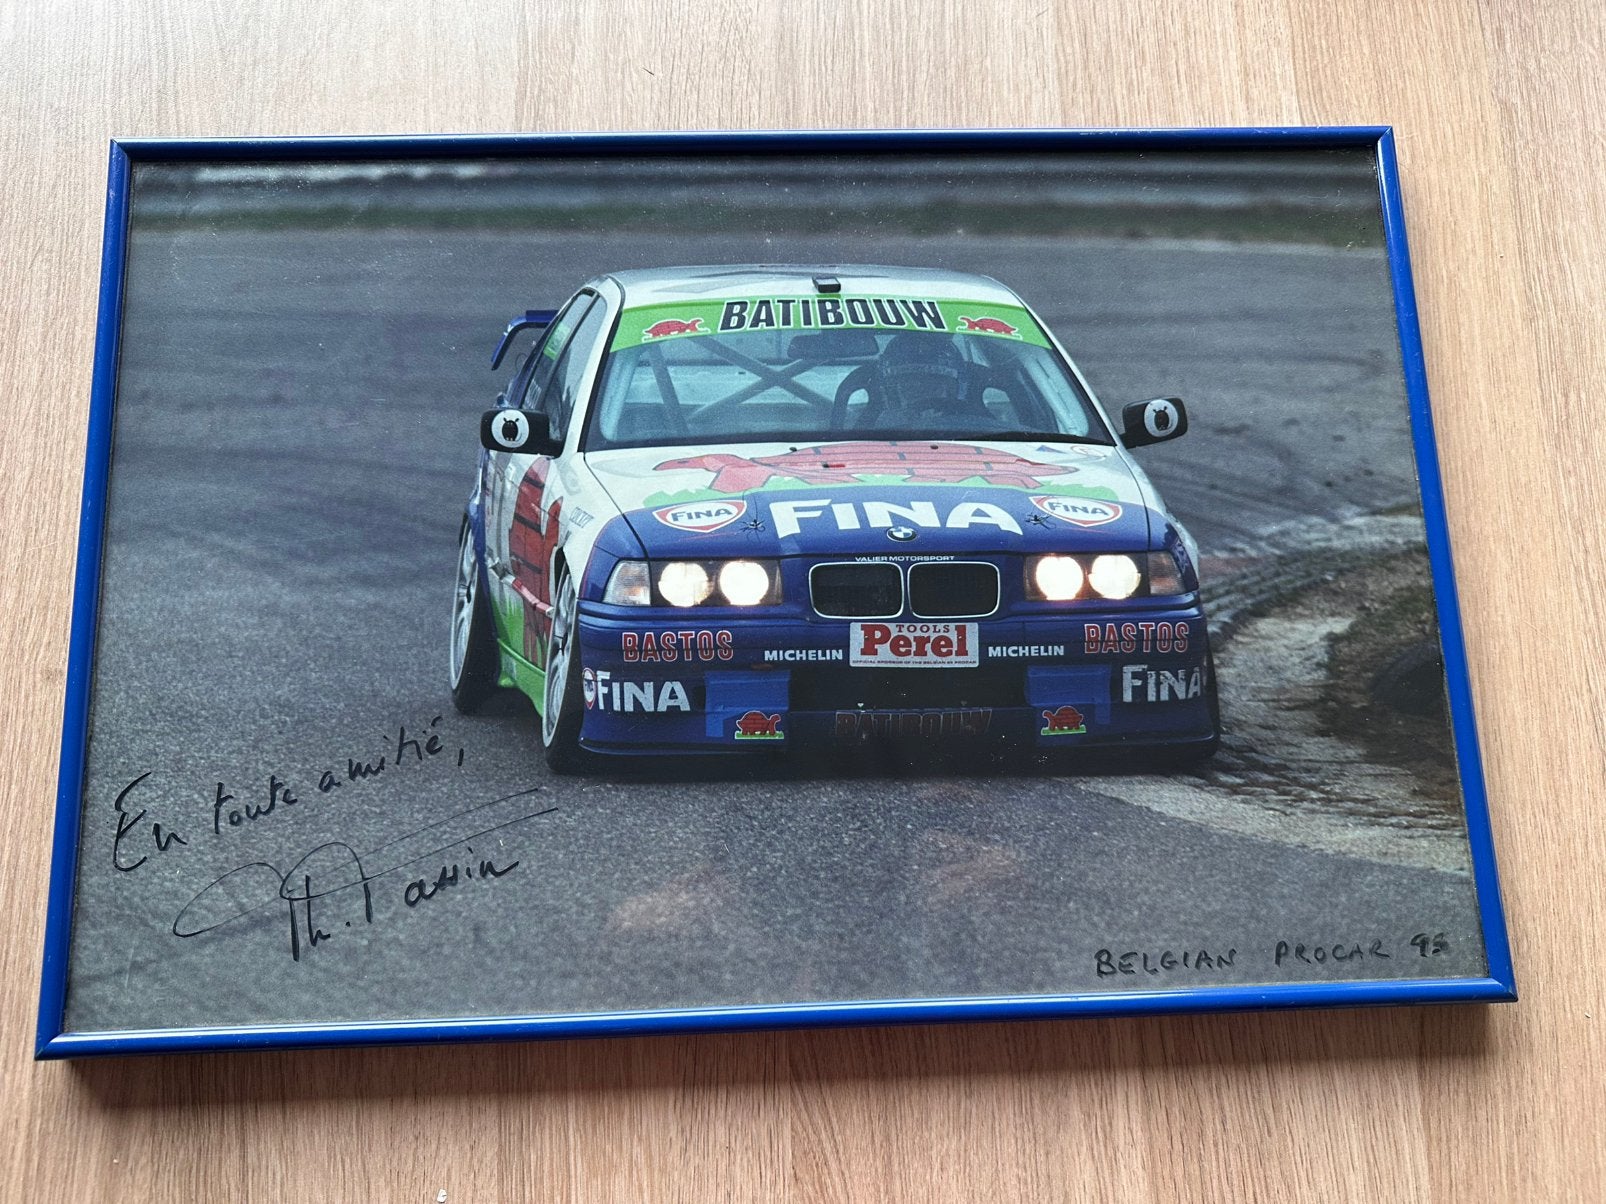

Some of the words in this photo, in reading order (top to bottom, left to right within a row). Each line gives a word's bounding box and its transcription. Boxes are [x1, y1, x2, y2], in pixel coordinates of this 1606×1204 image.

[717, 298, 948, 333] BATIBOUW
[671, 508, 733, 522] FINA
[769, 499, 1024, 540] FINA
[1048, 502, 1110, 517] FINA
[860, 623, 969, 658] Perel
[896, 624, 950, 633] TOOLS
[1084, 622, 1190, 654] BASTOS
[621, 630, 734, 662] BASTOS
[764, 649, 843, 662] MICHELIN
[988, 645, 1065, 658] MICHELIN
[596, 670, 691, 713] FINA
[1122, 664, 1201, 703] FINA
[1094, 947, 1238, 978] BELGIAN
[1273, 938, 1391, 969] PROCAR
